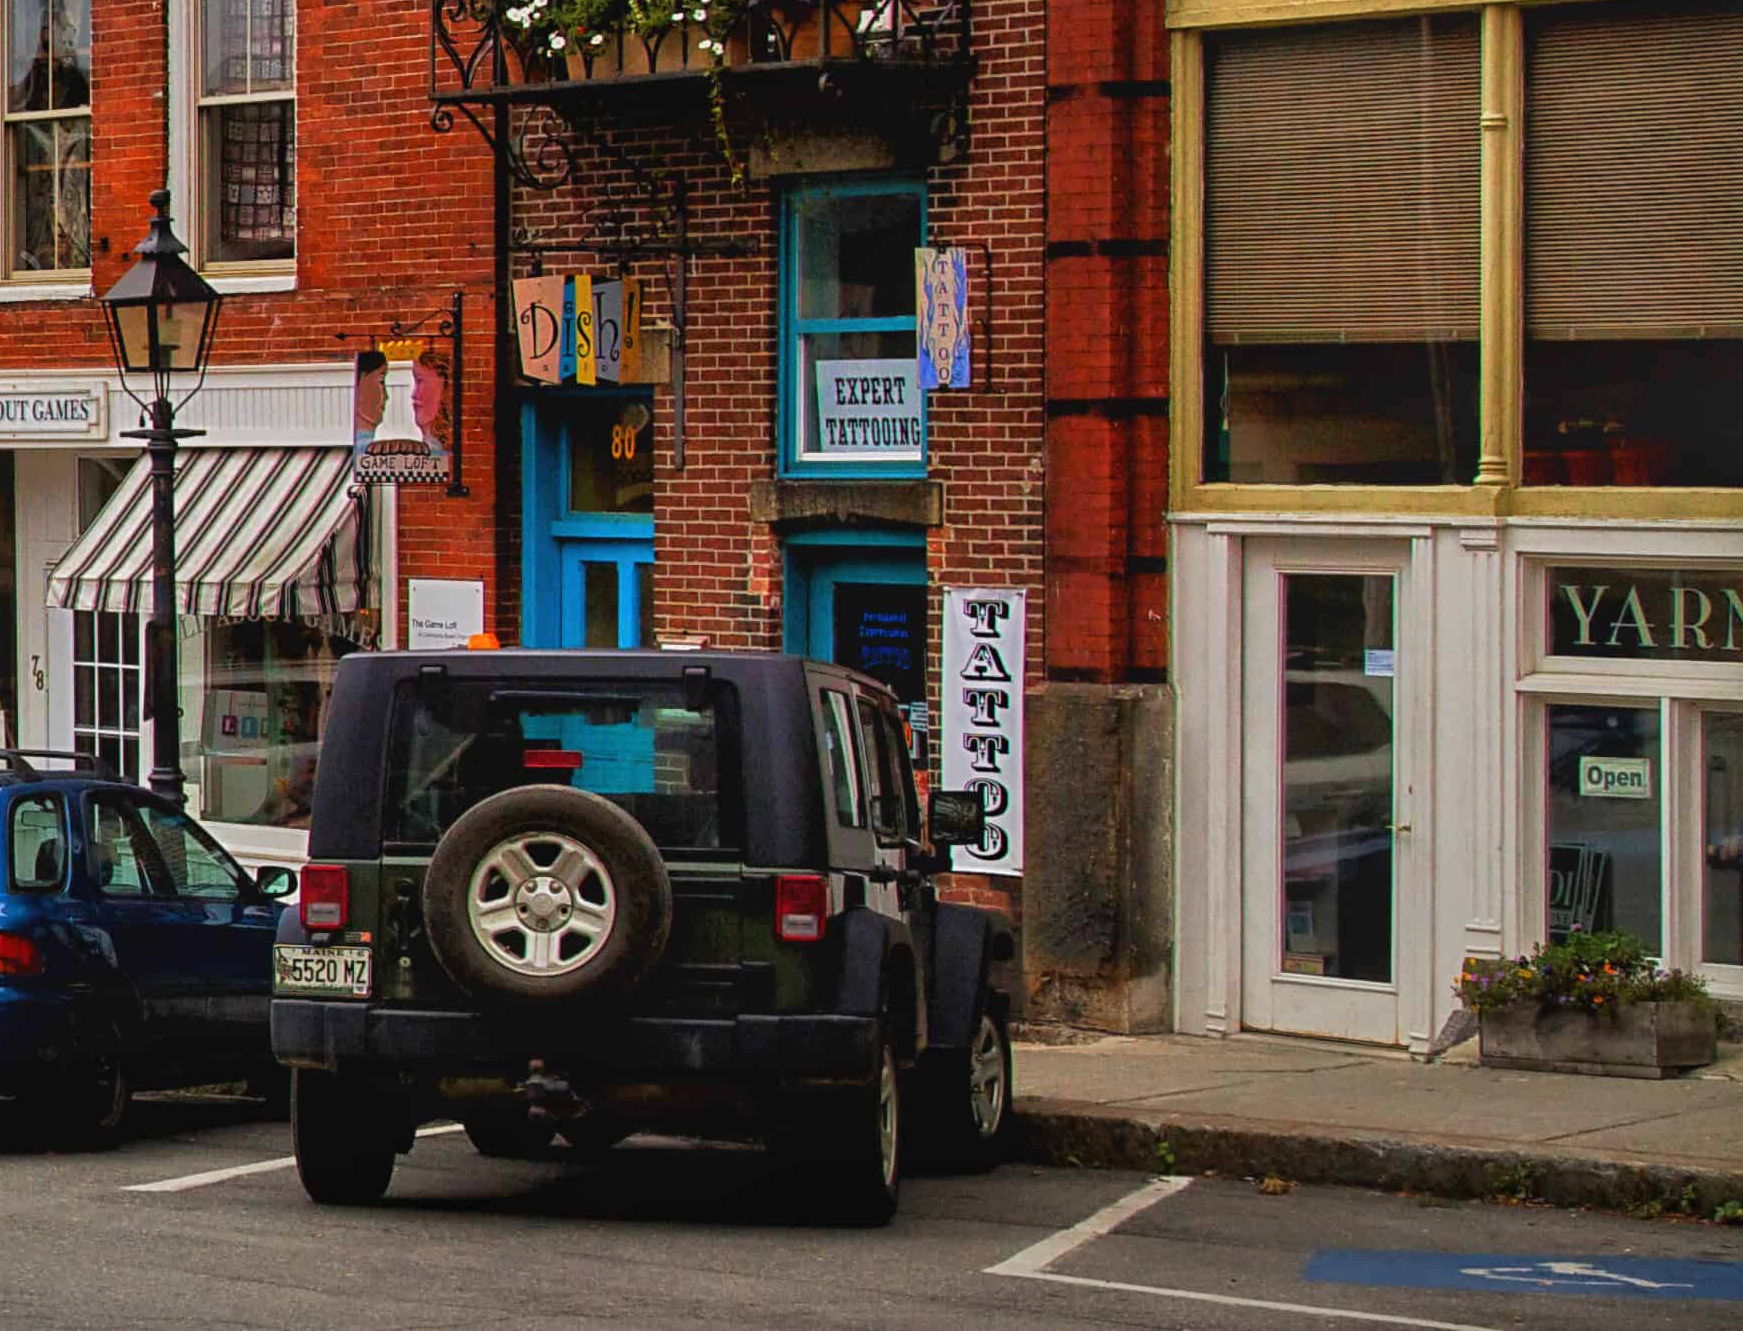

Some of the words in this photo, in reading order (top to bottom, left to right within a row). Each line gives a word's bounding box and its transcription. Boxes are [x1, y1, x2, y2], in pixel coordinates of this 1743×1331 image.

[937, 260, 949, 381] TATTOO
[834, 375, 906, 406] EXPERT
[32, 399, 90, 422] GAMES
[611, 425, 635, 460] 80
[825, 417, 921, 446] TATTOOING
[361, 456, 396, 469] GAME
[404, 457, 441, 470] LOFT
[1587, 765, 1643, 790] Open
[292, 958, 337, 983] 5520
[343, 959, 366, 984] MZ
